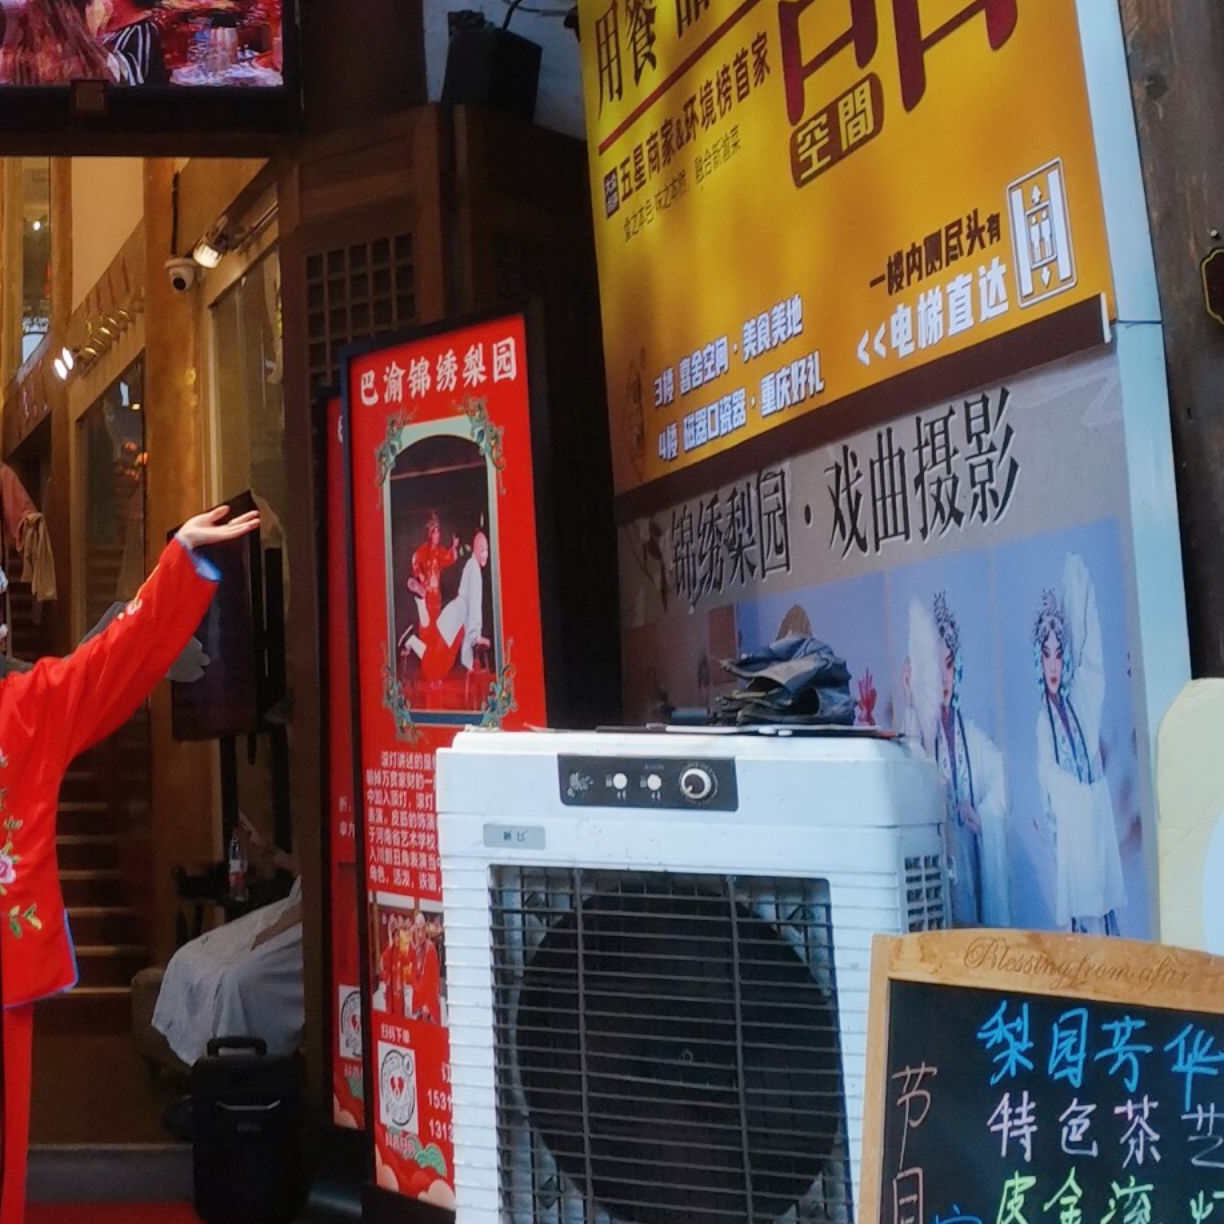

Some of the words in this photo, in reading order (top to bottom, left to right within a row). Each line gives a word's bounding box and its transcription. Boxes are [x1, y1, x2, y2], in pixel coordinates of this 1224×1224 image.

[797, 79, 874, 181] 空間
[869, 207, 1001, 296] 一楼内侧尽头有
[890, 256, 1009, 358] 电梯直达
[360, 336, 517, 407] 巴渝锦绣梨园
[672, 387, 1019, 601] 锦绣梨园·戏曲摄影
[964, 937, 1073, 990] Blessing
[1072, 953, 1130, 986] from
[1137, 955, 1192, 992] afar
[976, 999, 1224, 1113] 梨园芳华
[986, 1090, 1224, 1170] 特色茶艺
